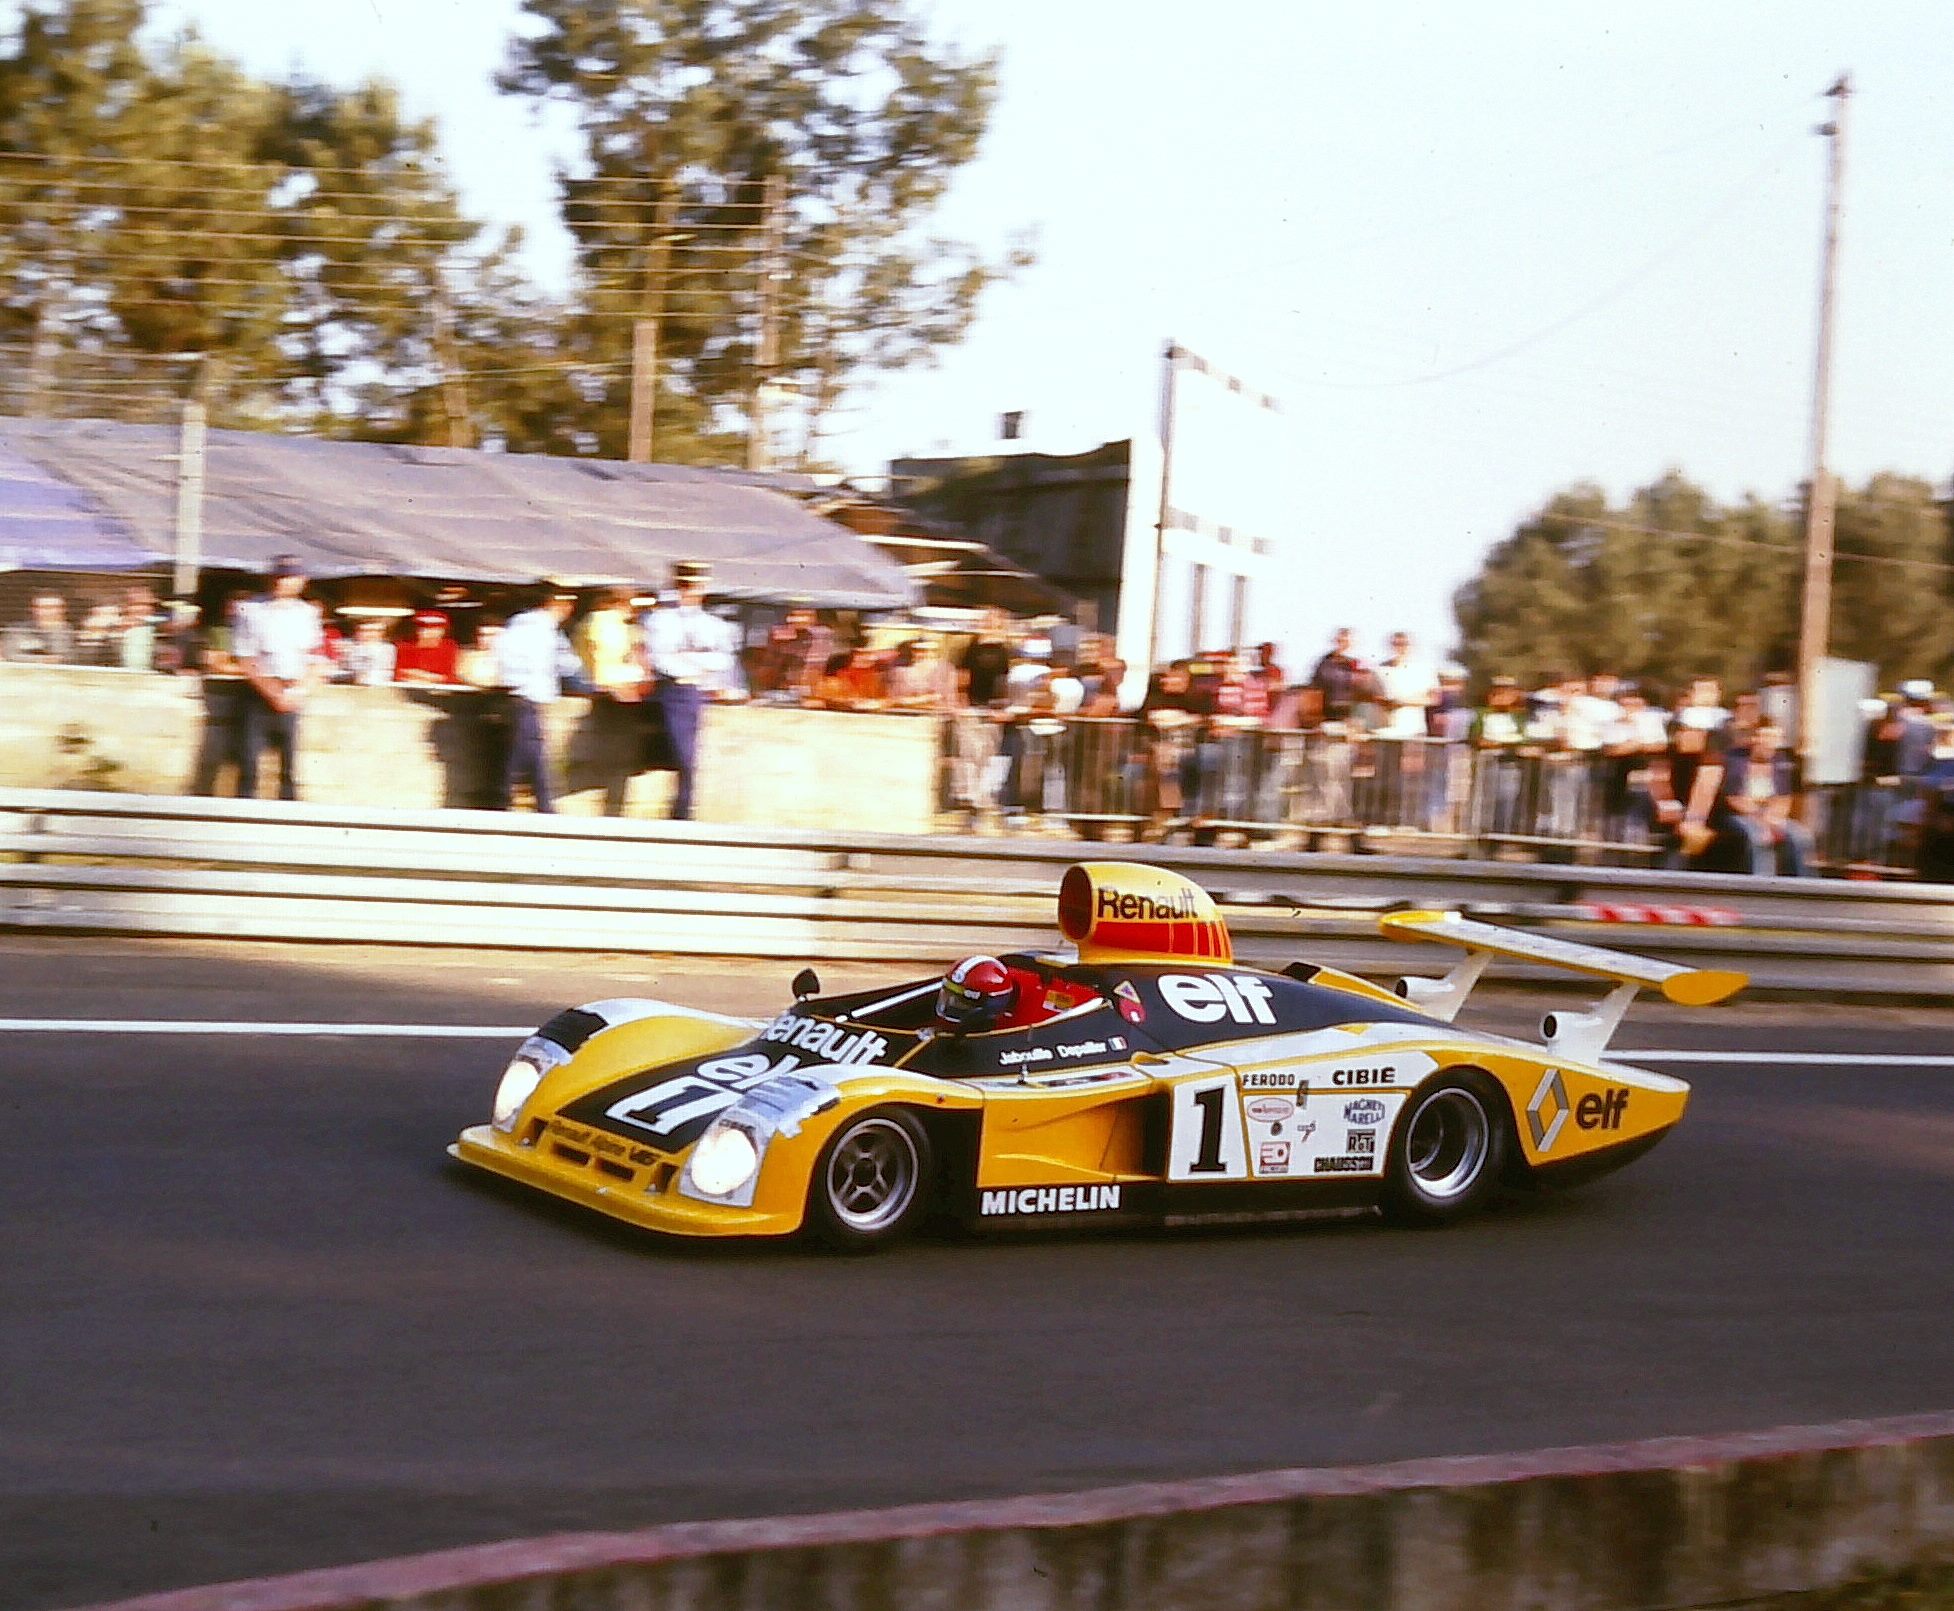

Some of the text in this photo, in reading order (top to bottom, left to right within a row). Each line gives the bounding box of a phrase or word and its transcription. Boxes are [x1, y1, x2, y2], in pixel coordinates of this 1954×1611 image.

[1098, 888, 1198, 919] Renault
[1157, 974, 1277, 1025] elf
[760, 1012, 889, 1065] enault
[697, 1053, 801, 1090] el
[1243, 1073, 1296, 1087] FERODO
[1575, 1088, 1631, 1130] elf
[1190, 1086, 1227, 1172] 1
[981, 1185, 1120, 1215] MICHELIN
